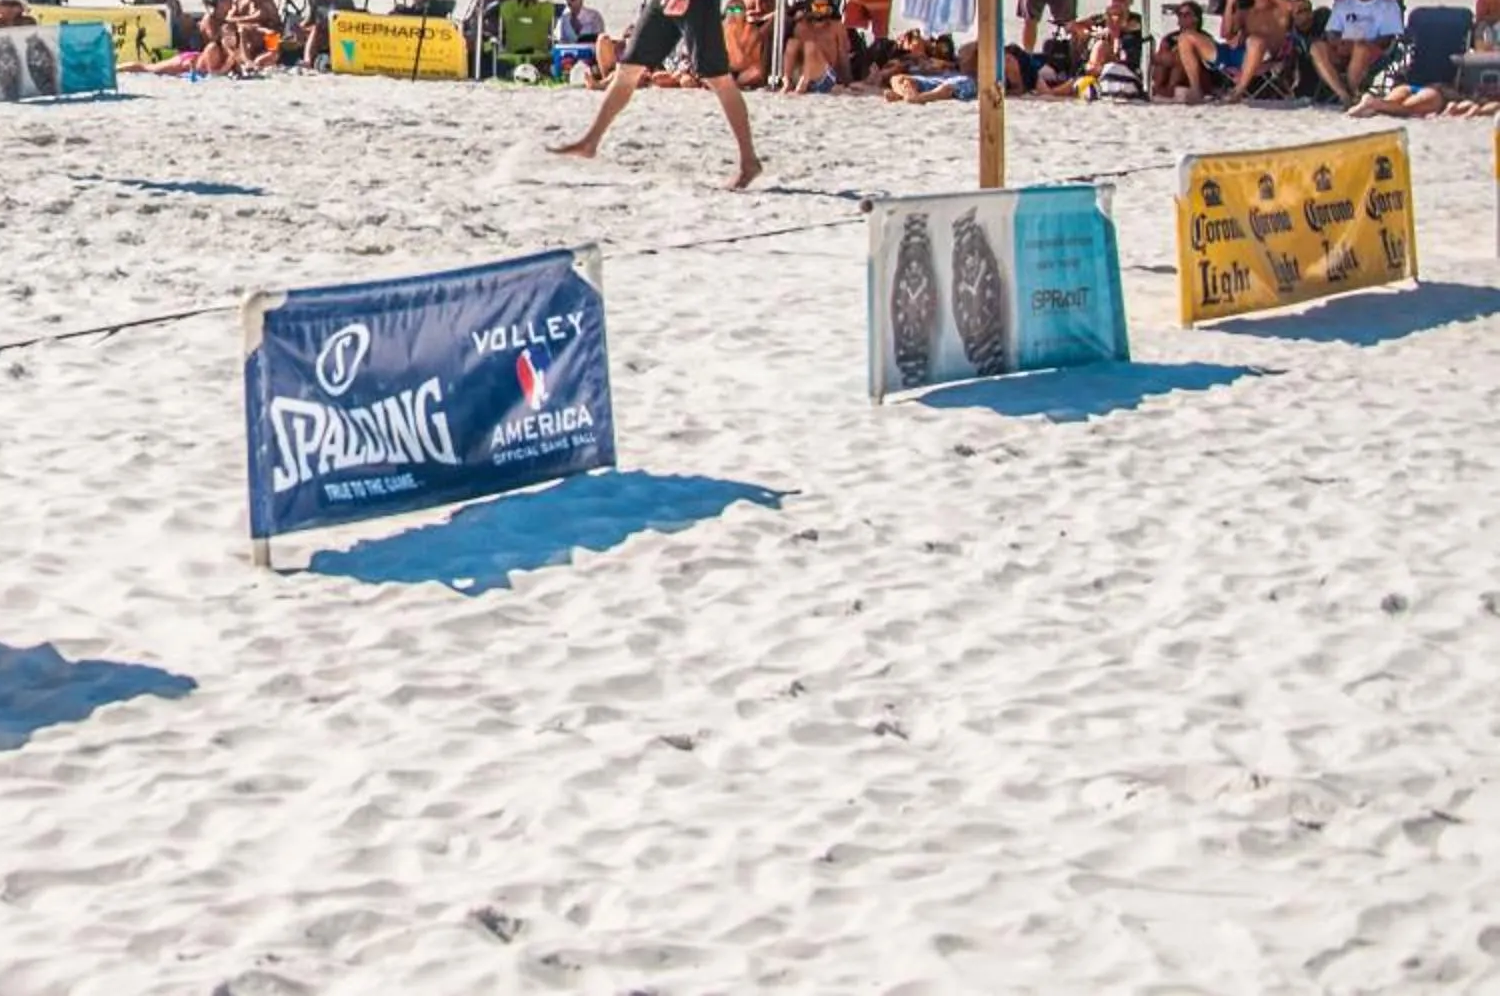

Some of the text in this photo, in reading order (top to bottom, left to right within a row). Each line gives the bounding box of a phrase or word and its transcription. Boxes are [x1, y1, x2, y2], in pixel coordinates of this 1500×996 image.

[337, 21, 453, 41] SHEPHARD'S
[472, 311, 585, 354] VOLLEY
[270, 377, 459, 492] SPALDING
[490, 404, 594, 451] AMERICA
